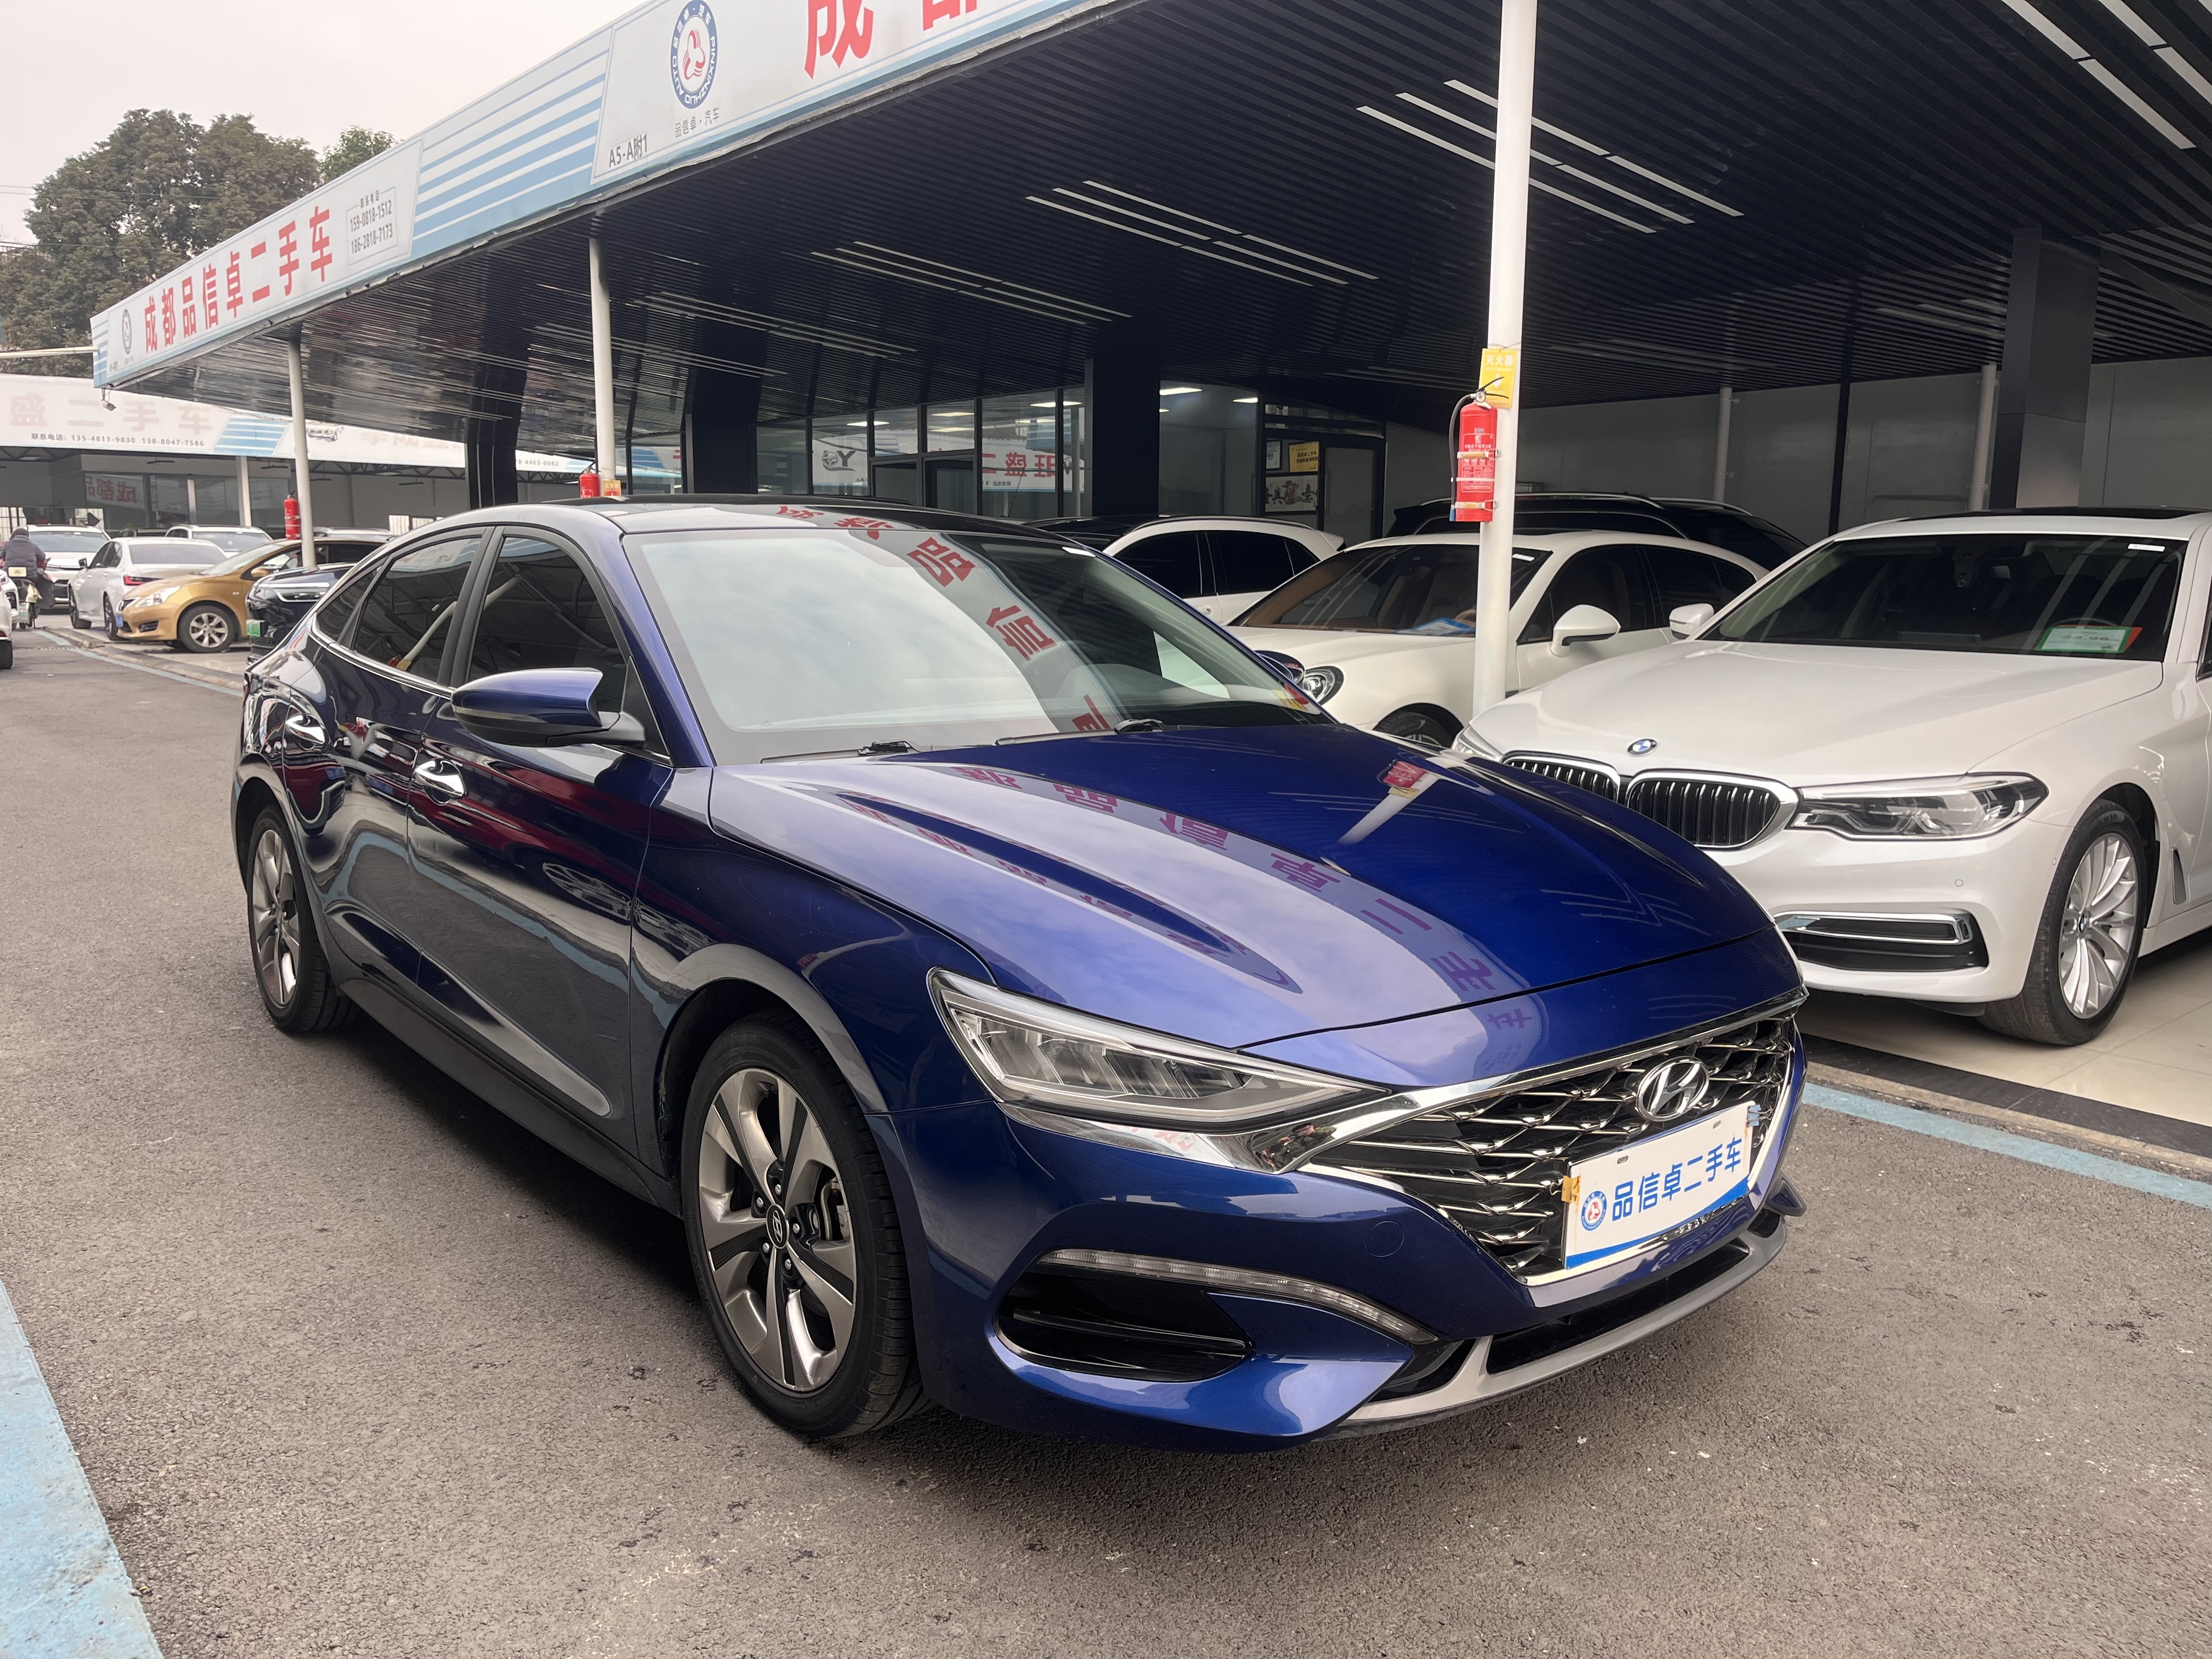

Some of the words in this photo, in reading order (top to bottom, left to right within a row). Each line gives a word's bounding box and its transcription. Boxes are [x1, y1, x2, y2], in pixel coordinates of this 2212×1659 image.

[672, 55, 684, 95] AUTO
[685, 36, 715, 104] PINXINZHUO
[350, 199, 392, 232] 159-0818-1512
[351, 222, 393, 254] 186-2818-7173
[144, 206, 332, 354] 成都品信卓二手车
[1485, 354, 1514, 366] 灭火器
[71, 435, 136, 444] 135-4811-9830
[1612, 1137, 1742, 1222] 品信卓二手车
